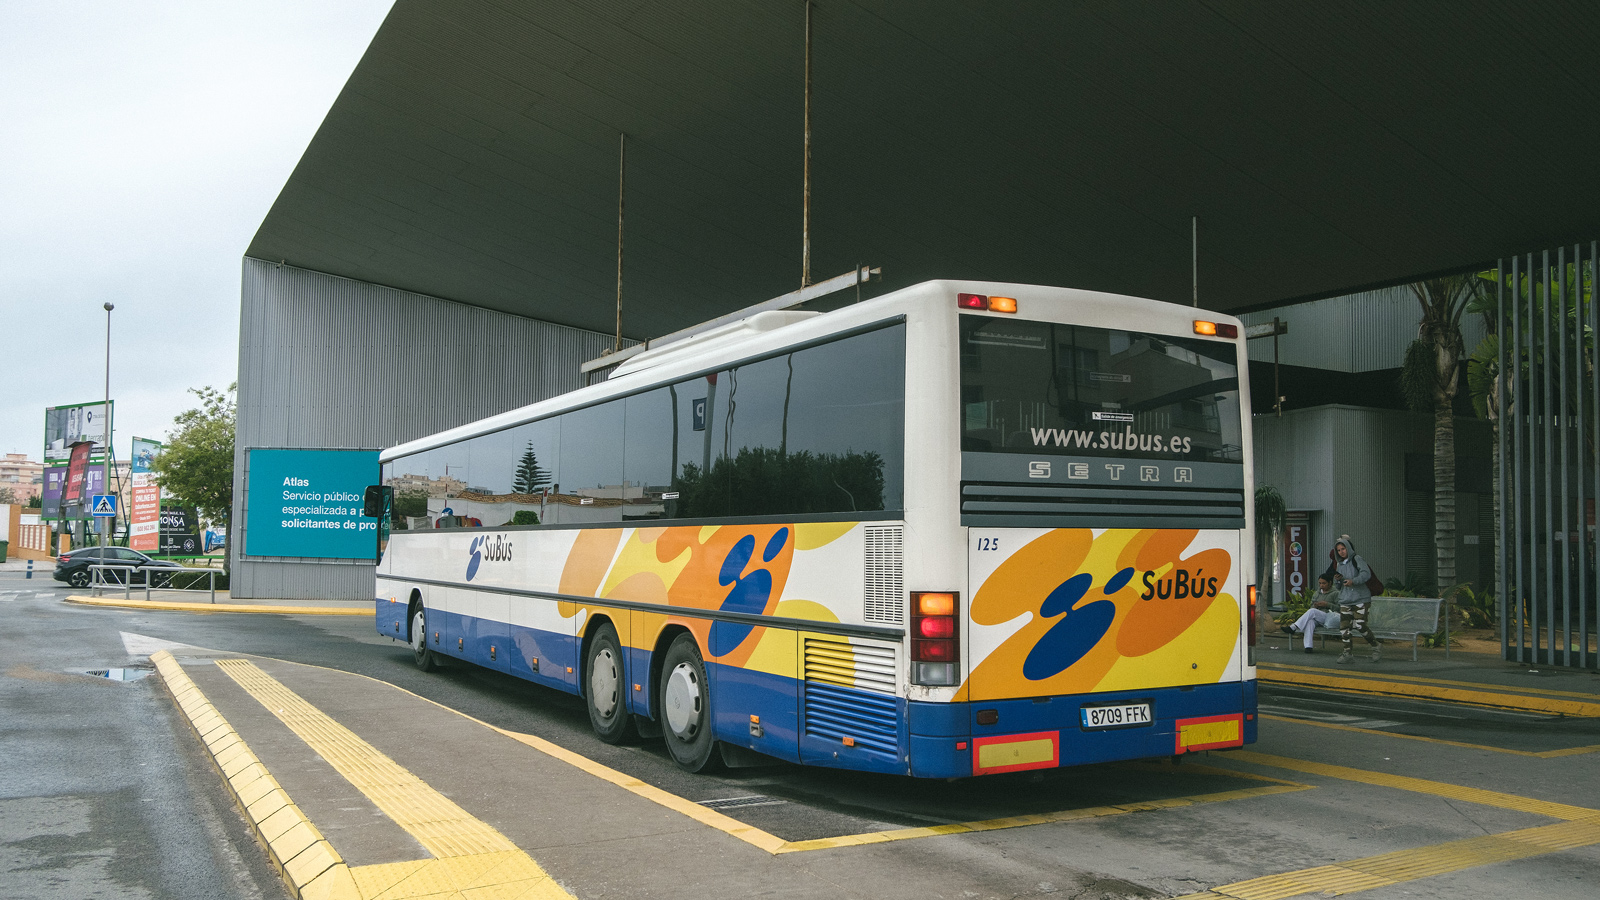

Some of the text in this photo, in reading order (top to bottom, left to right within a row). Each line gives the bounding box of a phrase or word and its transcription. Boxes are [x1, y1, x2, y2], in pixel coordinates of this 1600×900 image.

[1030, 426, 1191, 453] www.subus.es
[1029, 461, 1193, 483] SETRA
[283, 477, 309, 487] Atlas
[282, 490, 321, 500] Servicio
[324, 491, 360, 502] público
[282, 505, 347, 516] especializada
[282, 519, 340, 528] solicitantes
[343, 520, 356, 529] de
[359, 522, 378, 532] pro
[484, 534, 512, 562] SuBús
[977, 538, 999, 551] 125
[1141, 568, 1218, 601] SuBús
[1091, 708, 1122, 724] 8709
[1126, 706, 1148, 722] FFK
